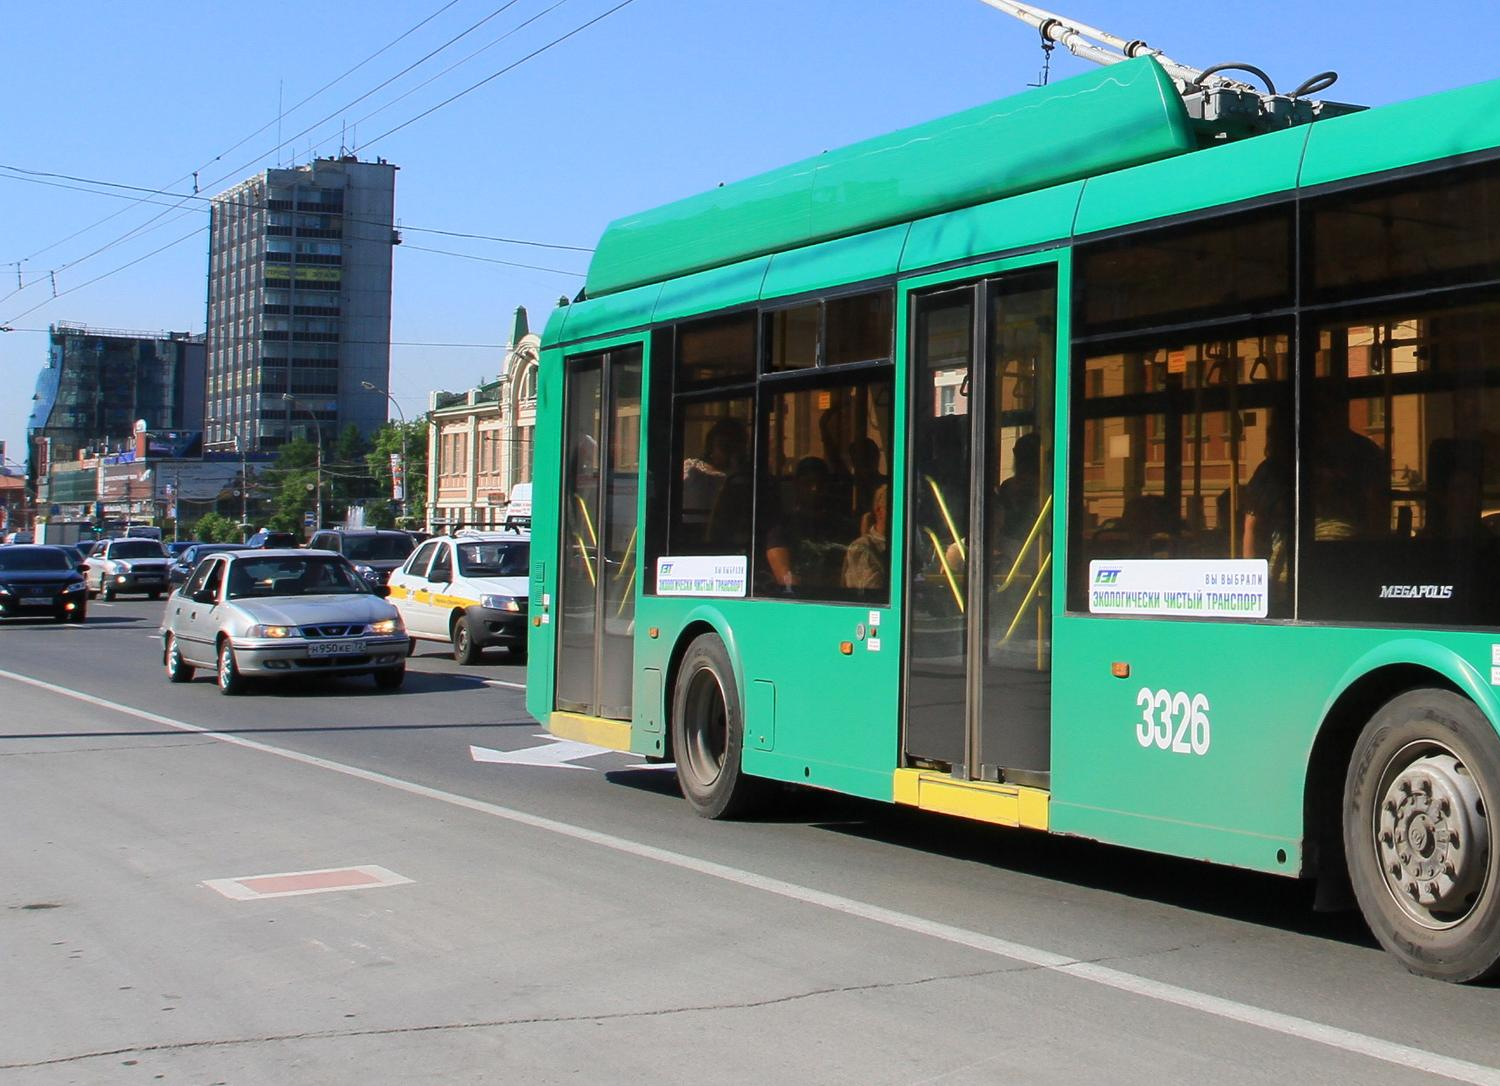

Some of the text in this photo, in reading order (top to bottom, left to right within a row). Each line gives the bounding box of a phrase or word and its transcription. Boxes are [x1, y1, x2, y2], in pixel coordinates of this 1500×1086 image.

[1205, 574, 1263, 585] ВЫ ВЫБРАЛИ
[1093, 590, 1263, 611] ЭКОЛОГИЧЕСКИ ЧИСТЫЙ ТРАНСПОРТ
[1379, 585, 1453, 599] MEGAPOLIS
[1136, 687, 1211, 755] 3326
